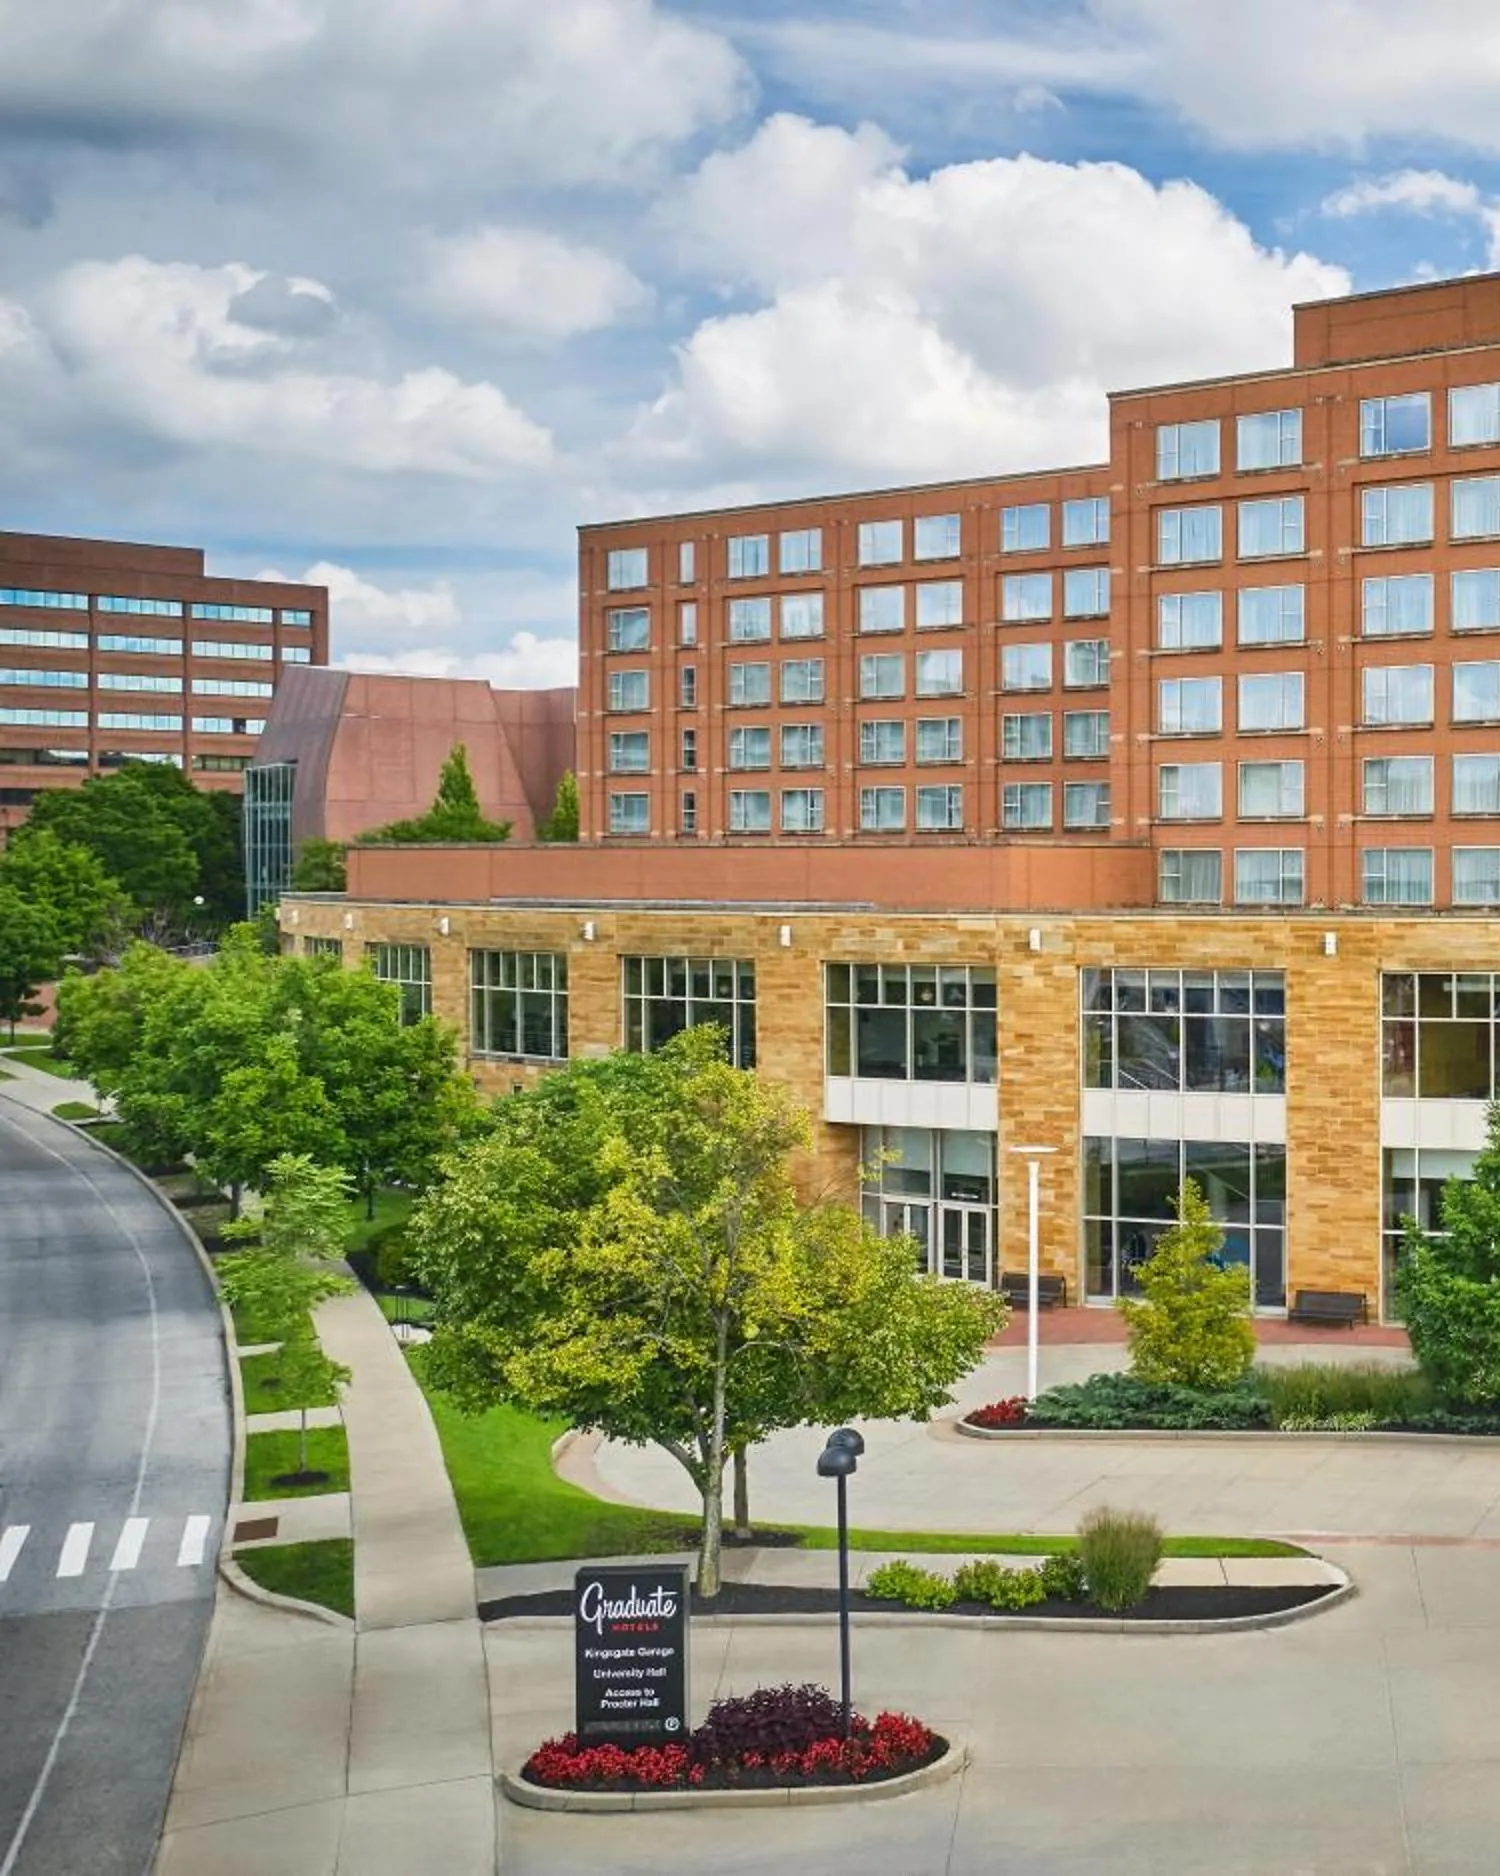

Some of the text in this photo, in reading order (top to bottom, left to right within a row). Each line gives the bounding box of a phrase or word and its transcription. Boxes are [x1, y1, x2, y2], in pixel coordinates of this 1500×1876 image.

[580, 1581, 678, 1636] Graduate
[610, 1622, 660, 1633] HOTELS
[584, 1646, 675, 1660] Kingsgate Garage
[593, 1667, 667, 1679] University Hall
[605, 1687, 655, 1697] Access to
[639, 1697, 660, 1708] Hall
